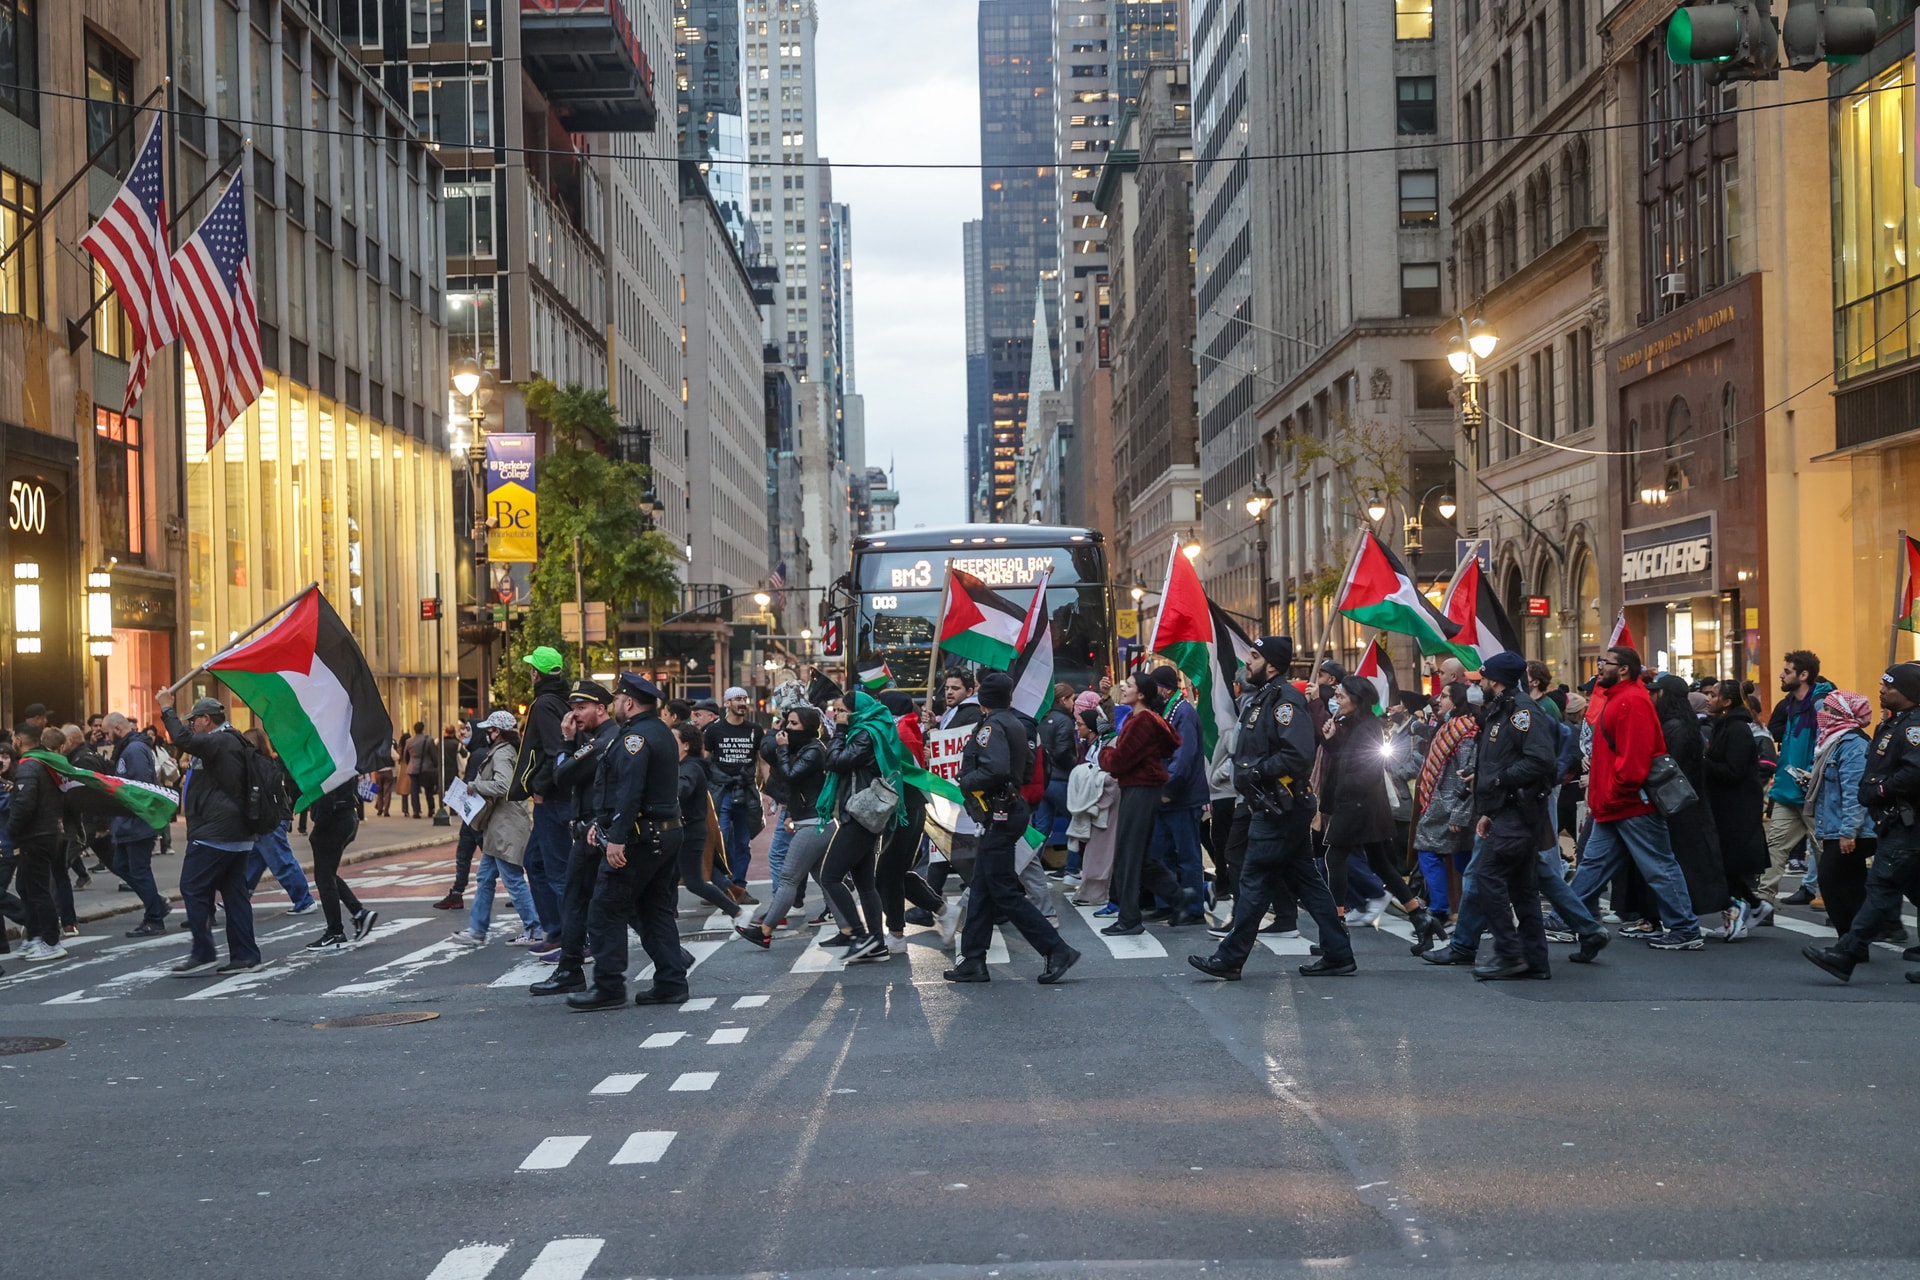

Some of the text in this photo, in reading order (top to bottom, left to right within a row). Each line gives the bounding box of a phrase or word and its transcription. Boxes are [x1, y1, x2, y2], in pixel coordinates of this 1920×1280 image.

[1684, 322, 1695, 342] OF
[1698, 304, 1734, 336] MIDTOWN
[498, 461, 531, 472] Berkeley
[500, 469, 529, 480] College
[9, 480, 46, 535] 500
[493, 501, 531, 529] Be
[1027, 557, 1052, 571] BAY
[1621, 538, 1709, 583] SKECHERS
[891, 560, 932, 587] BM3
[1017, 569, 1034, 583] AV
[872, 596, 898, 610] 003
